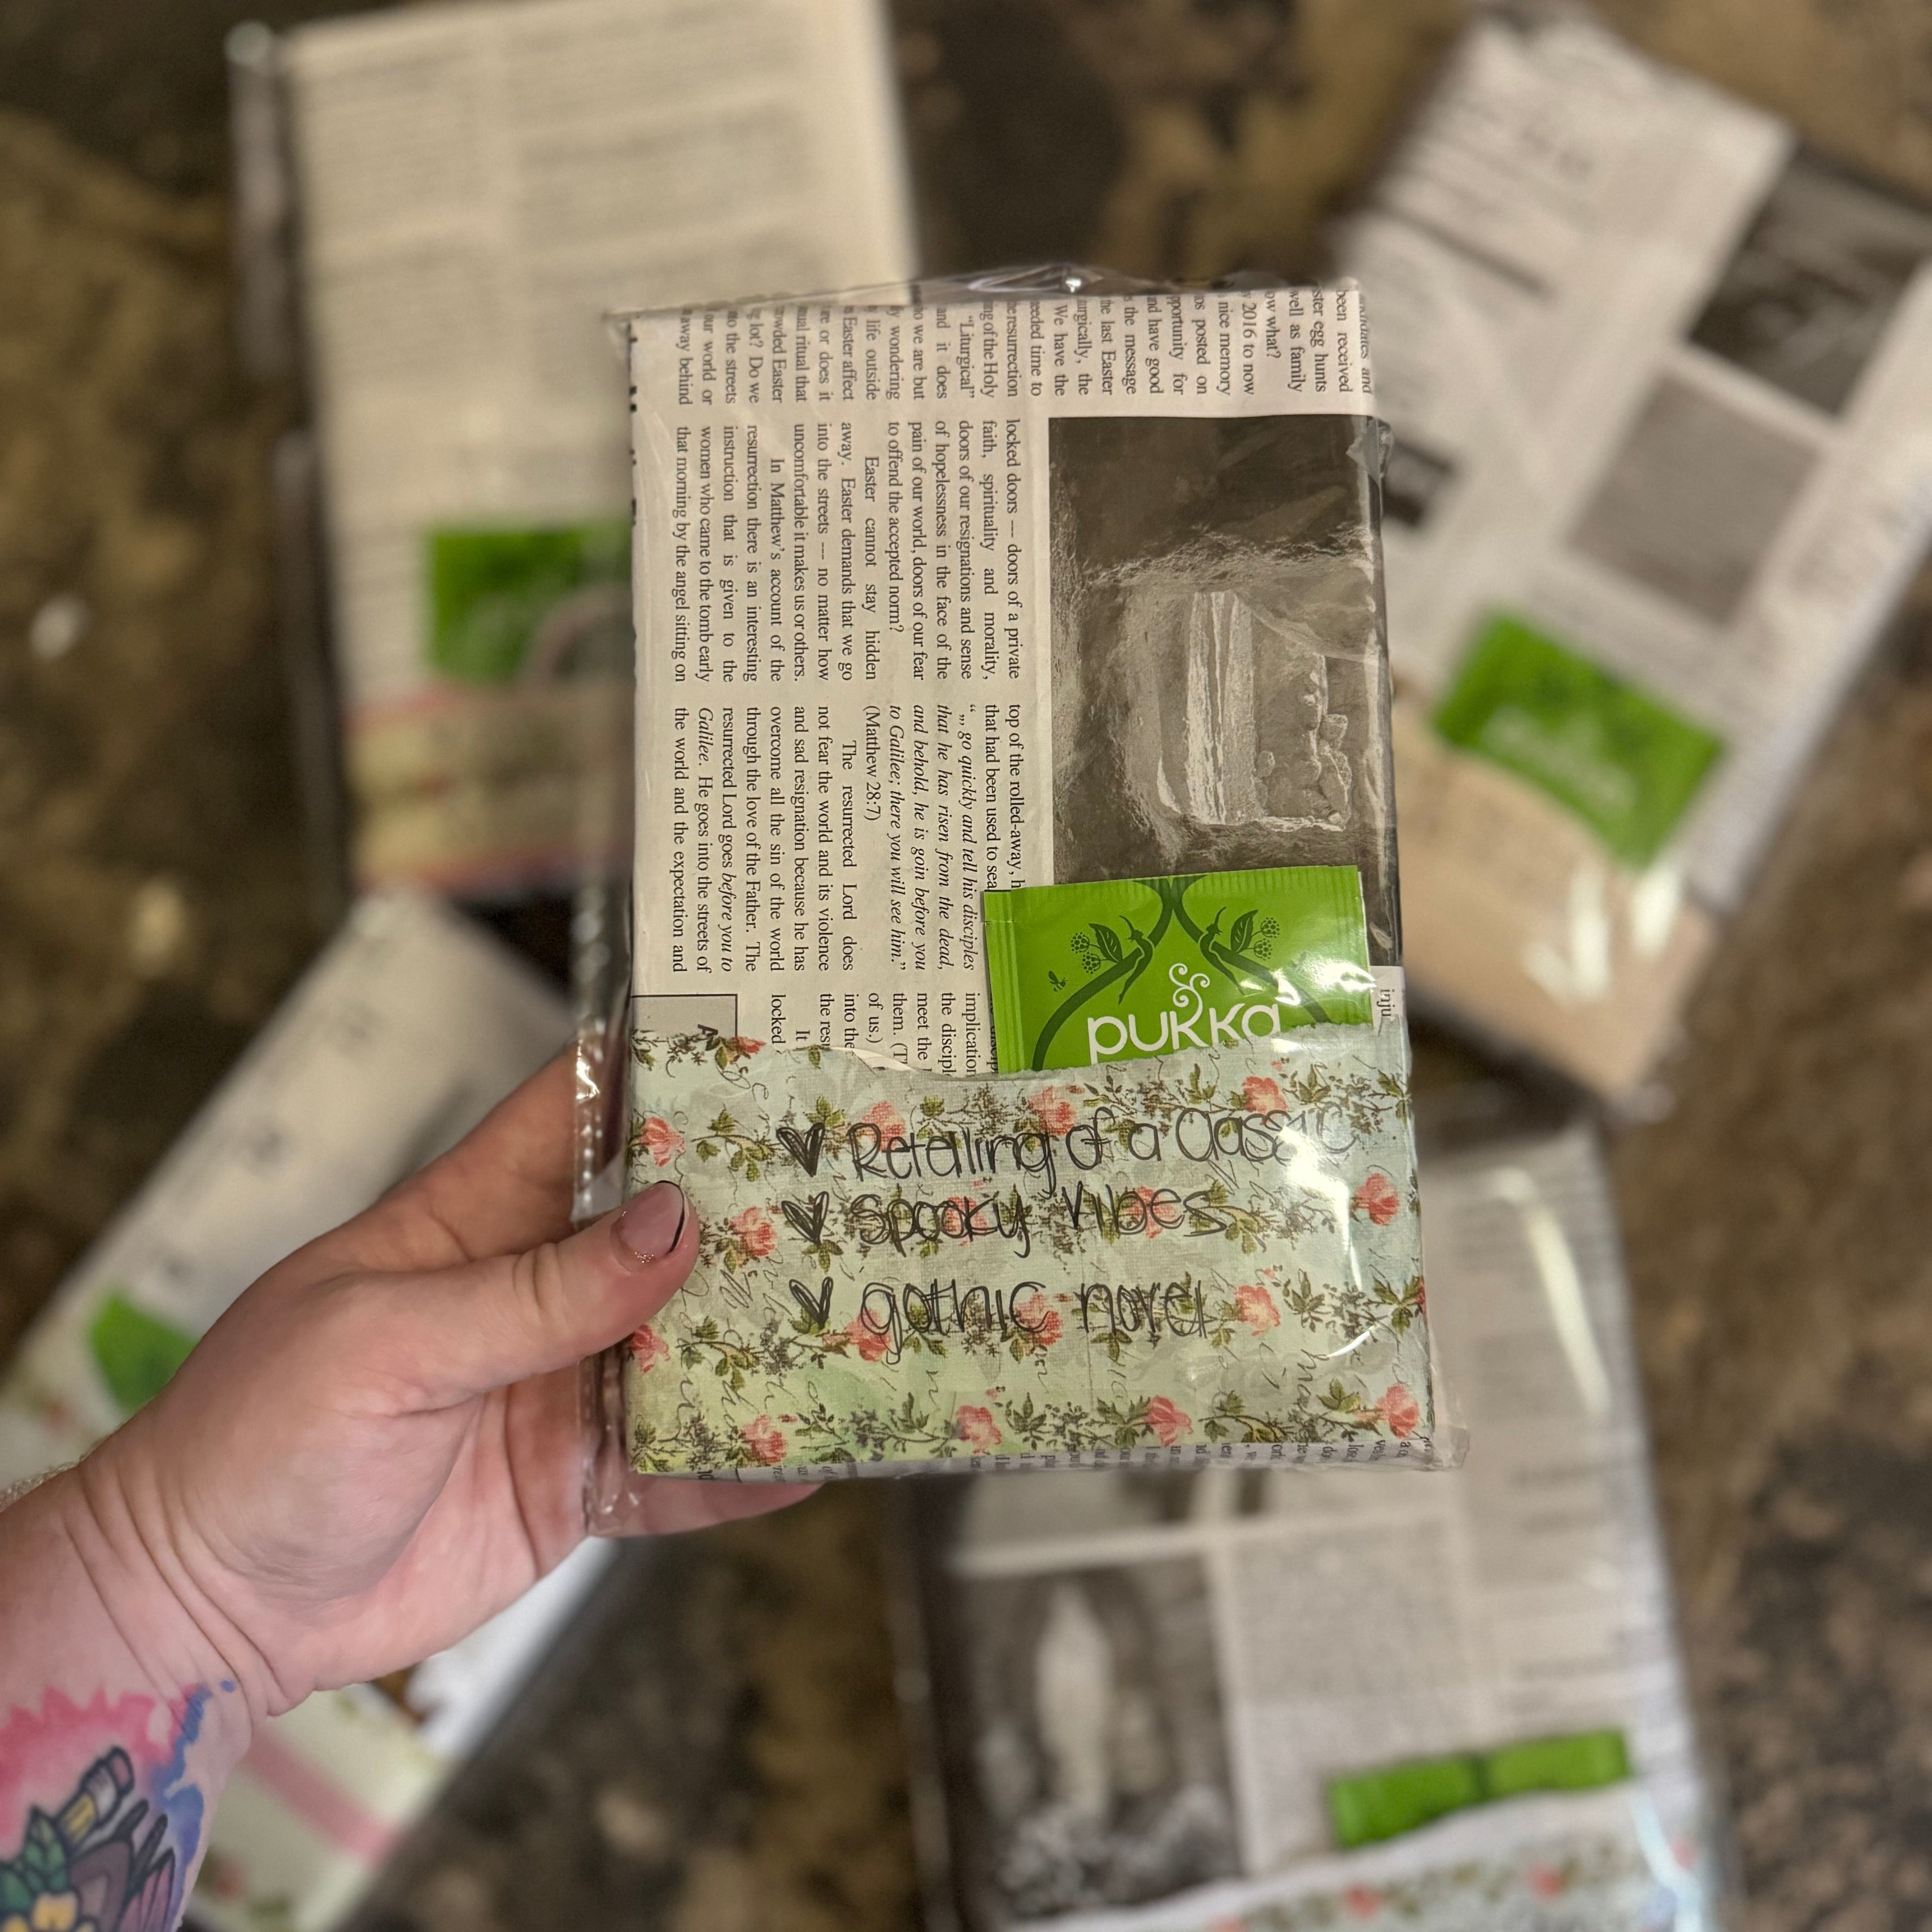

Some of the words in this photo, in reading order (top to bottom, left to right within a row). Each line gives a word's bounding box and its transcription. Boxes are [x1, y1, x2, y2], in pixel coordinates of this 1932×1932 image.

[1123, 307, 1138, 326] the
[1218, 302, 1232, 329] nice
[1241, 303, 1256, 339] 2016
[1100, 321, 1114, 344] last
[1148, 319, 1162, 351] have
[1191, 319, 1210, 365] posted
[1265, 316, 1280, 359] what?
[1289, 324, 1301, 339] as
[1310, 321, 1324, 347] egg
[1121, 335, 1136, 395] message
[1216, 333, 1230, 395] memory
[1242, 344, 1255, 359] to
[1337, 332, 1352, 393] received
[1101, 350, 1115, 395] Easter
[1145, 358, 1163, 394] good
[1172, 373, 1187, 395] for
[1242, 364, 1253, 395] now
[1287, 347, 1305, 392] family
[1313, 353, 1328, 392] hunts
[1195, 376, 1206, 394] on
[676, 426, 691, 453] that
[887, 421, 900, 436] to
[907, 421, 926, 453] pain
[934, 421, 950, 438] of
[958, 420, 974, 461] doors
[980, 420, 997, 458] faith,
[770, 458, 785, 473] In
[793, 424, 809, 529] uncomfortable
[887, 439, 903, 488] offend
[911, 456, 927, 474] of
[958, 465, 974, 483] of
[671, 457, 691, 519] morning
[864, 456, 879, 503] Easter
[911, 476, 922, 503] our
[931, 443, 950, 537] hopelessness
[888, 491, 903, 514] the
[958, 485, 970, 511] our
[978, 473, 998, 551] spirituality
[671, 522, 690, 541] by
[770, 482, 785, 560] Matthew’s
[909, 505, 927, 554] world,
[793, 532, 809, 542] it
[864, 517, 877, 568] cannot
[883, 517, 904, 582] accepted
[935, 544, 951, 558] in
[675, 544, 691, 568] the
[793, 544, 809, 592] makes
[955, 515, 975, 603] resignations
[671, 571, 690, 610] angel
[912, 556, 927, 598] doors
[935, 565, 951, 589] the
[983, 568, 998, 595] and
[769, 569, 782, 626] account
[793, 594, 804, 611] us
[860, 584, 877, 613] stay
[888, 585, 904, 633] norm?
[912, 602, 928, 619] of
[935, 595, 951, 627] face
[793, 613, 804, 630] or
[912, 621, 923, 648] our
[959, 607, 975, 635] and
[670, 614, 690, 660] sitting
[769, 634, 785, 652] of
[935, 633, 952, 652] of
[980, 611, 999, 680] morality,
[793, 631, 809, 682] others.
[864, 630, 880, 680] hidden
[912, 651, 928, 681] fear
[936, 656, 952, 680] the
[959, 638, 971, 680] sense
[674, 664, 685, 682] on
[769, 659, 785, 682] the
[793, 706, 809, 733] and
[817, 706, 830, 730] not
[913, 704, 928, 734] and
[936, 704, 952, 734] that
[698, 707, 713, 766] Galilee.
[769, 706, 781, 780] overcome
[818, 736, 833, 765] fear
[862, 705, 880, 778] (Matthew
[937, 742, 952, 760] he
[793, 739, 809, 764] sad
[842, 740, 856, 770] The
[818, 770, 833, 794] the
[911, 740, 929, 795] behold,
[698, 776, 713, 798] He
[770, 787, 785, 805] all
[937, 769, 952, 796] has
[789, 769, 809, 851] resignation
[863, 782, 881, 821] 28:7)
[913, 802, 929, 821] he
[693, 802, 708, 837] goes
[770, 813, 785, 836] the
[818, 800, 833, 843] world
[842, 785, 857, 868] resurrected
[913, 828, 928, 840] is
[937, 804, 952, 842] risen
[696, 843, 712, 871] into
[769, 844, 785, 865] sin
[818, 850, 833, 877] and
[910, 846, 928, 880] goin
[934, 848, 953, 887] from
[697, 876, 712, 899] the
[769, 873, 785, 891] of
[793, 857, 809, 917] because
[818, 884, 833, 901] its
[769, 897, 785, 920] the
[842, 883, 857, 920] Lord
[910, 888, 929, 936] before
[938, 896, 954, 919] the
[696, 904, 709, 951] streets
[793, 922, 809, 940] he
[818, 908, 833, 972] violence
[769, 927, 784, 972] world
[793, 946, 809, 971] has
[842, 936, 857, 971] does
[910, 941, 925, 970] you
[936, 928, 954, 970] dead,
[696, 956, 711, 974] of
[820, 994, 834, 1016] the
[844, 994, 858, 1022] into
[868, 993, 883, 1010] of
[893, 993, 907, 1035] them.
[917, 993, 928, 1029] meet
[941, 992, 955, 1015] the
[771, 994, 785, 1044] locked
[865, 1016, 883, 1043] us.)
[795, 1030, 810, 1041] It
[917, 1037, 931, 1061] the
[890, 1043, 908, 1066] (T
[1065, 1106, 1115, 1170] of
[1127, 1122, 1162, 1161] a
